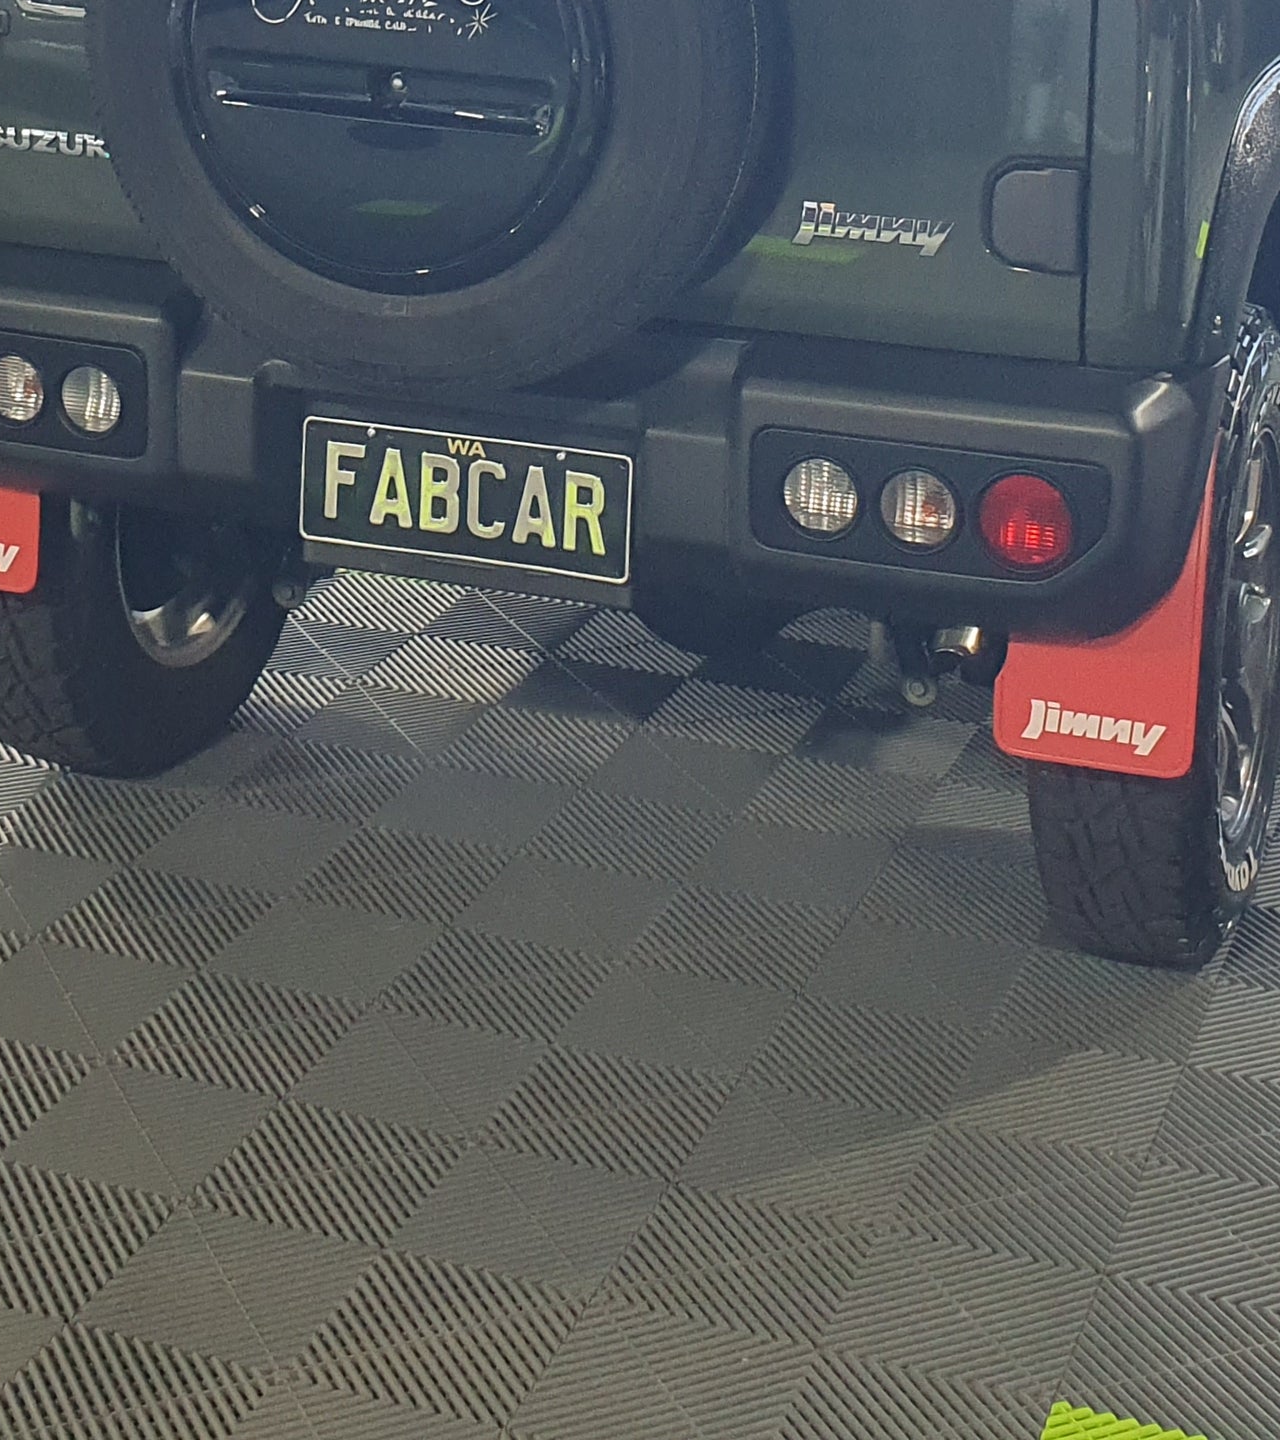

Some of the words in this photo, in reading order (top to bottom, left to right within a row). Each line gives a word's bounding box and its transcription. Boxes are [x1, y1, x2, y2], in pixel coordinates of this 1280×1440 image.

[792, 201, 954, 257] Jimny
[447, 438, 486, 458] WA
[324, 440, 606, 556] FABCAR
[1020, 698, 1167, 756] Jimny
